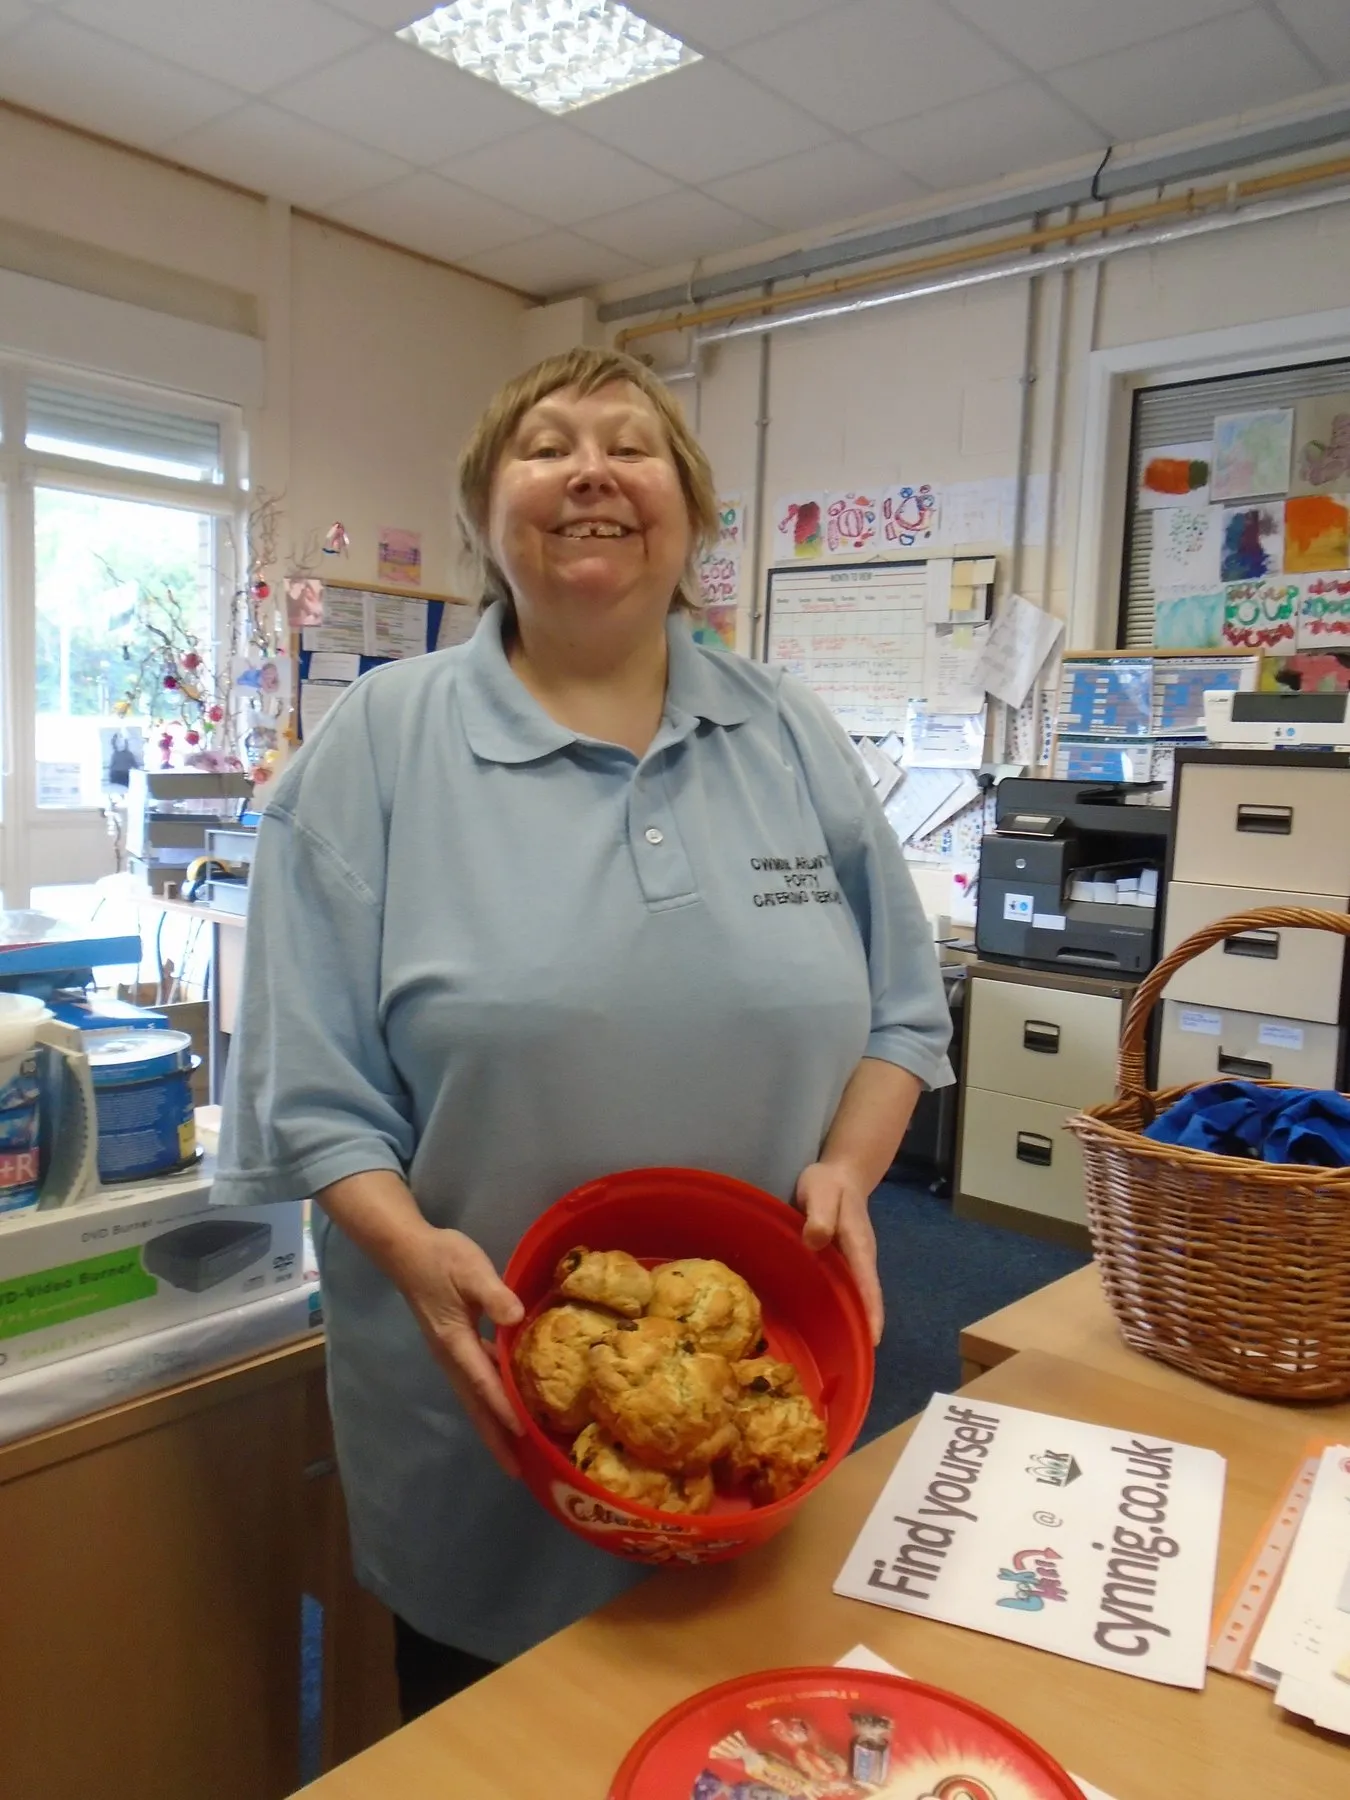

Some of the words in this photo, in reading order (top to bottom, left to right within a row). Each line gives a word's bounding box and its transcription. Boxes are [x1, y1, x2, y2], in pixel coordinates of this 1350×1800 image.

[867, 1515, 956, 1600] Find
[918, 1405, 1001, 1523] yourself
[1032, 1510, 1063, 1528] @
[1092, 1438, 1180, 1657] cynnig.co.uk
